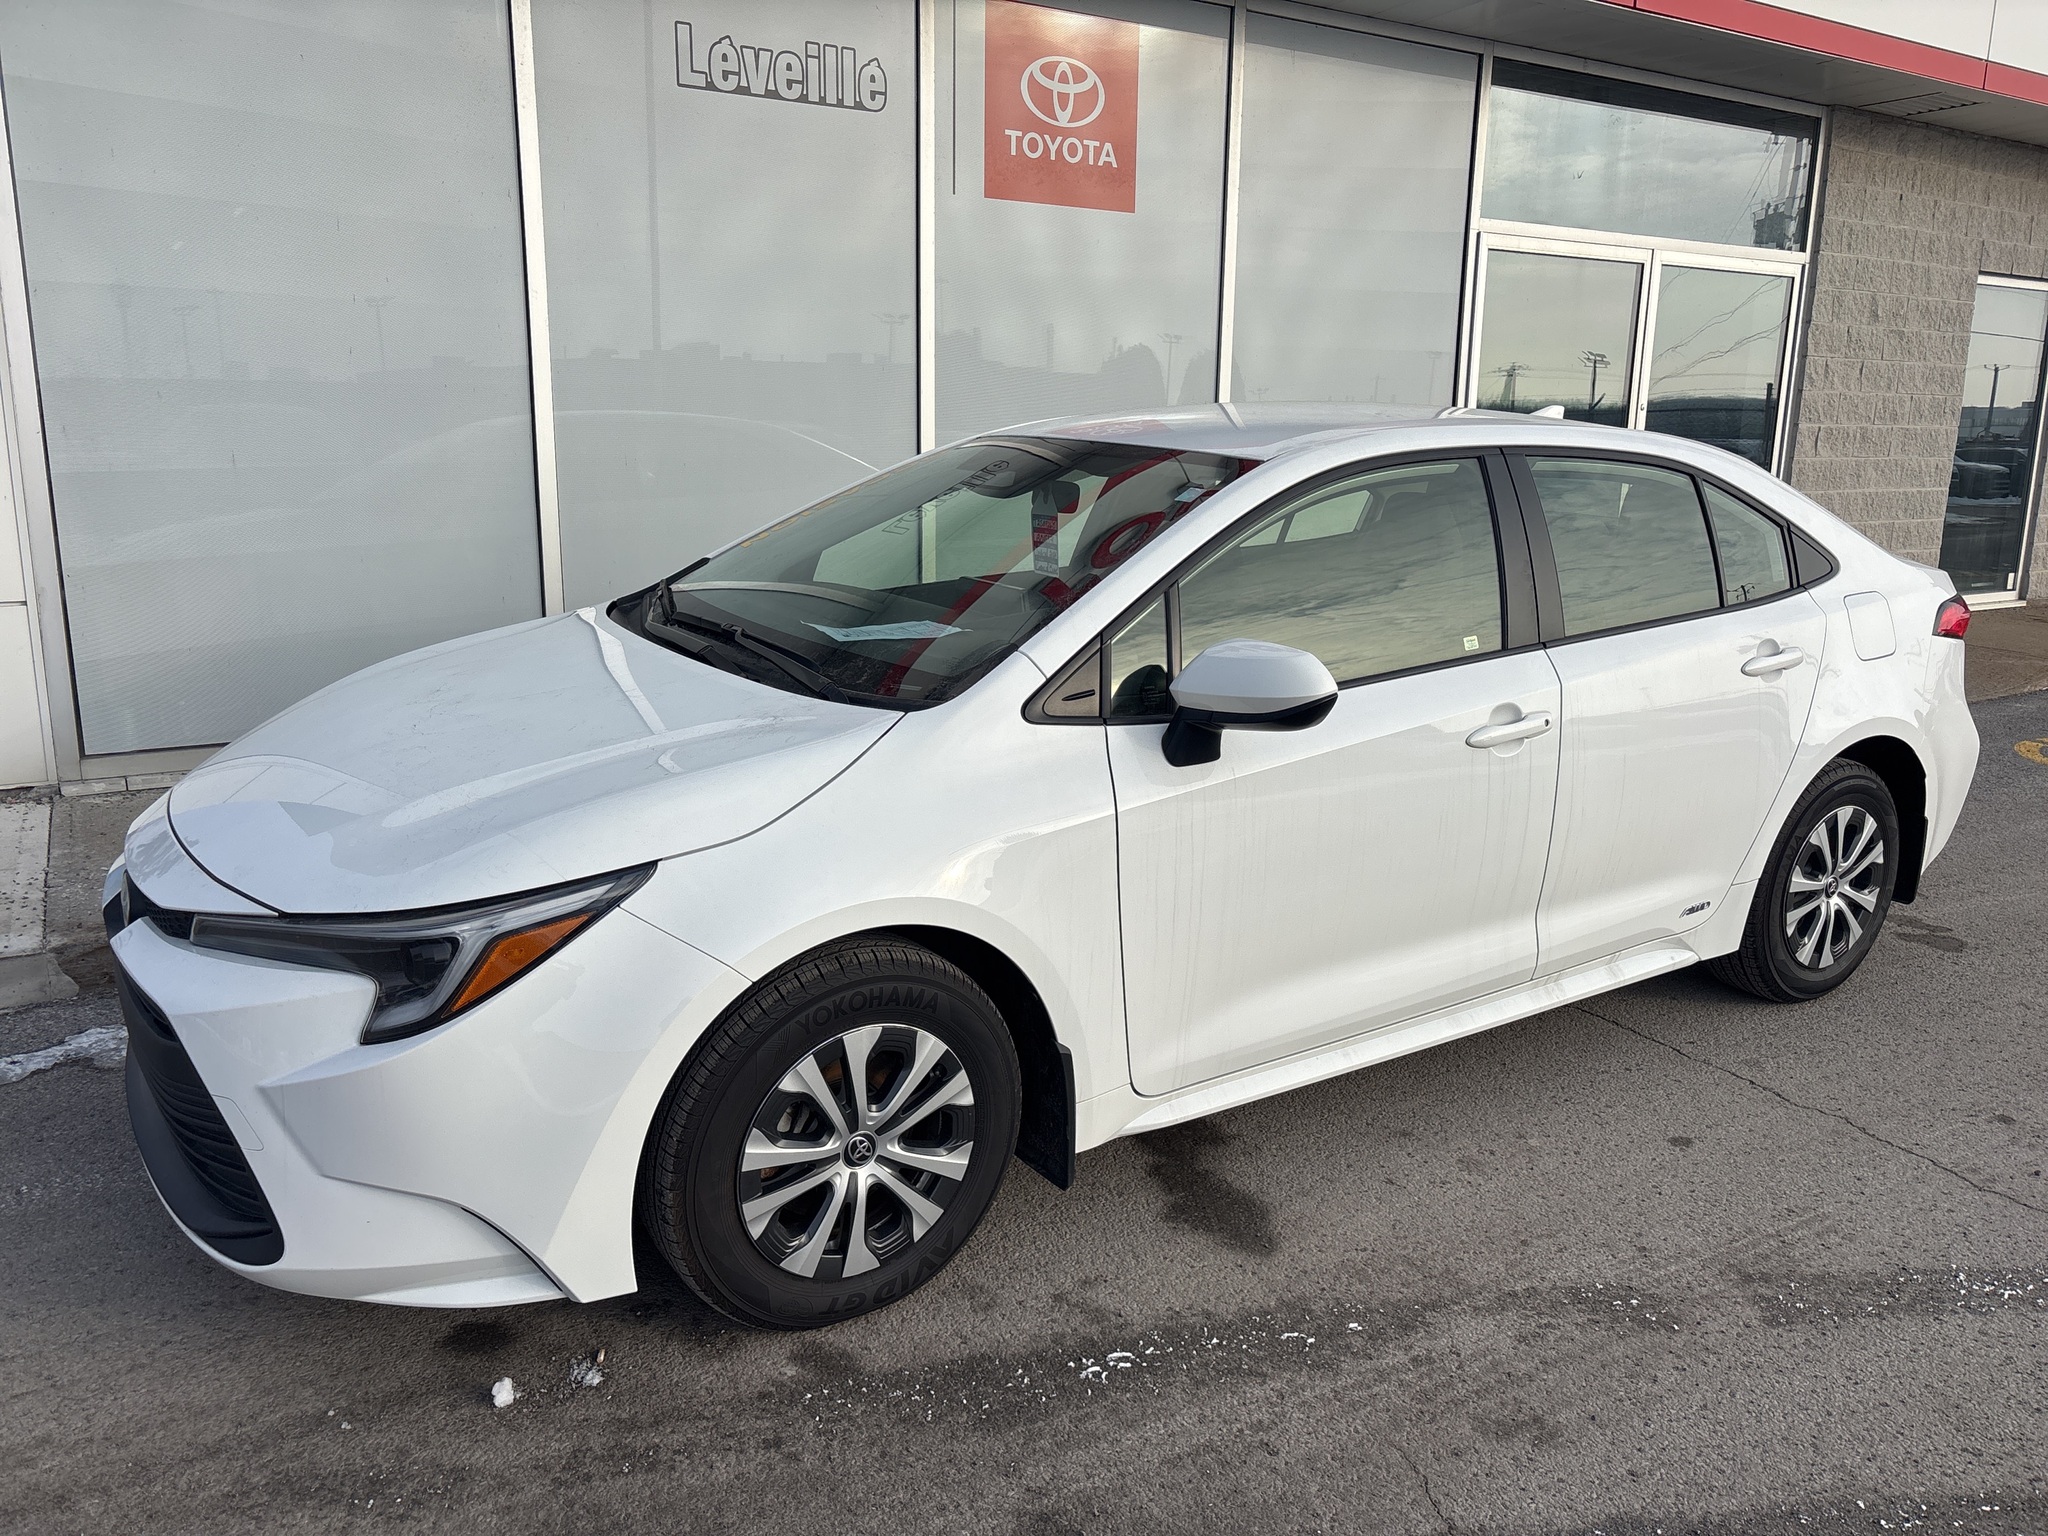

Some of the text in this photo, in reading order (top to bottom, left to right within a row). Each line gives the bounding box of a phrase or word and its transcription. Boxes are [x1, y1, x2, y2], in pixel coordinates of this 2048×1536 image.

[675, 20, 888, 113] Léveillé
[1004, 128, 1118, 168] TOYOTA
[794, 985, 940, 1036] YOKOHAMA
